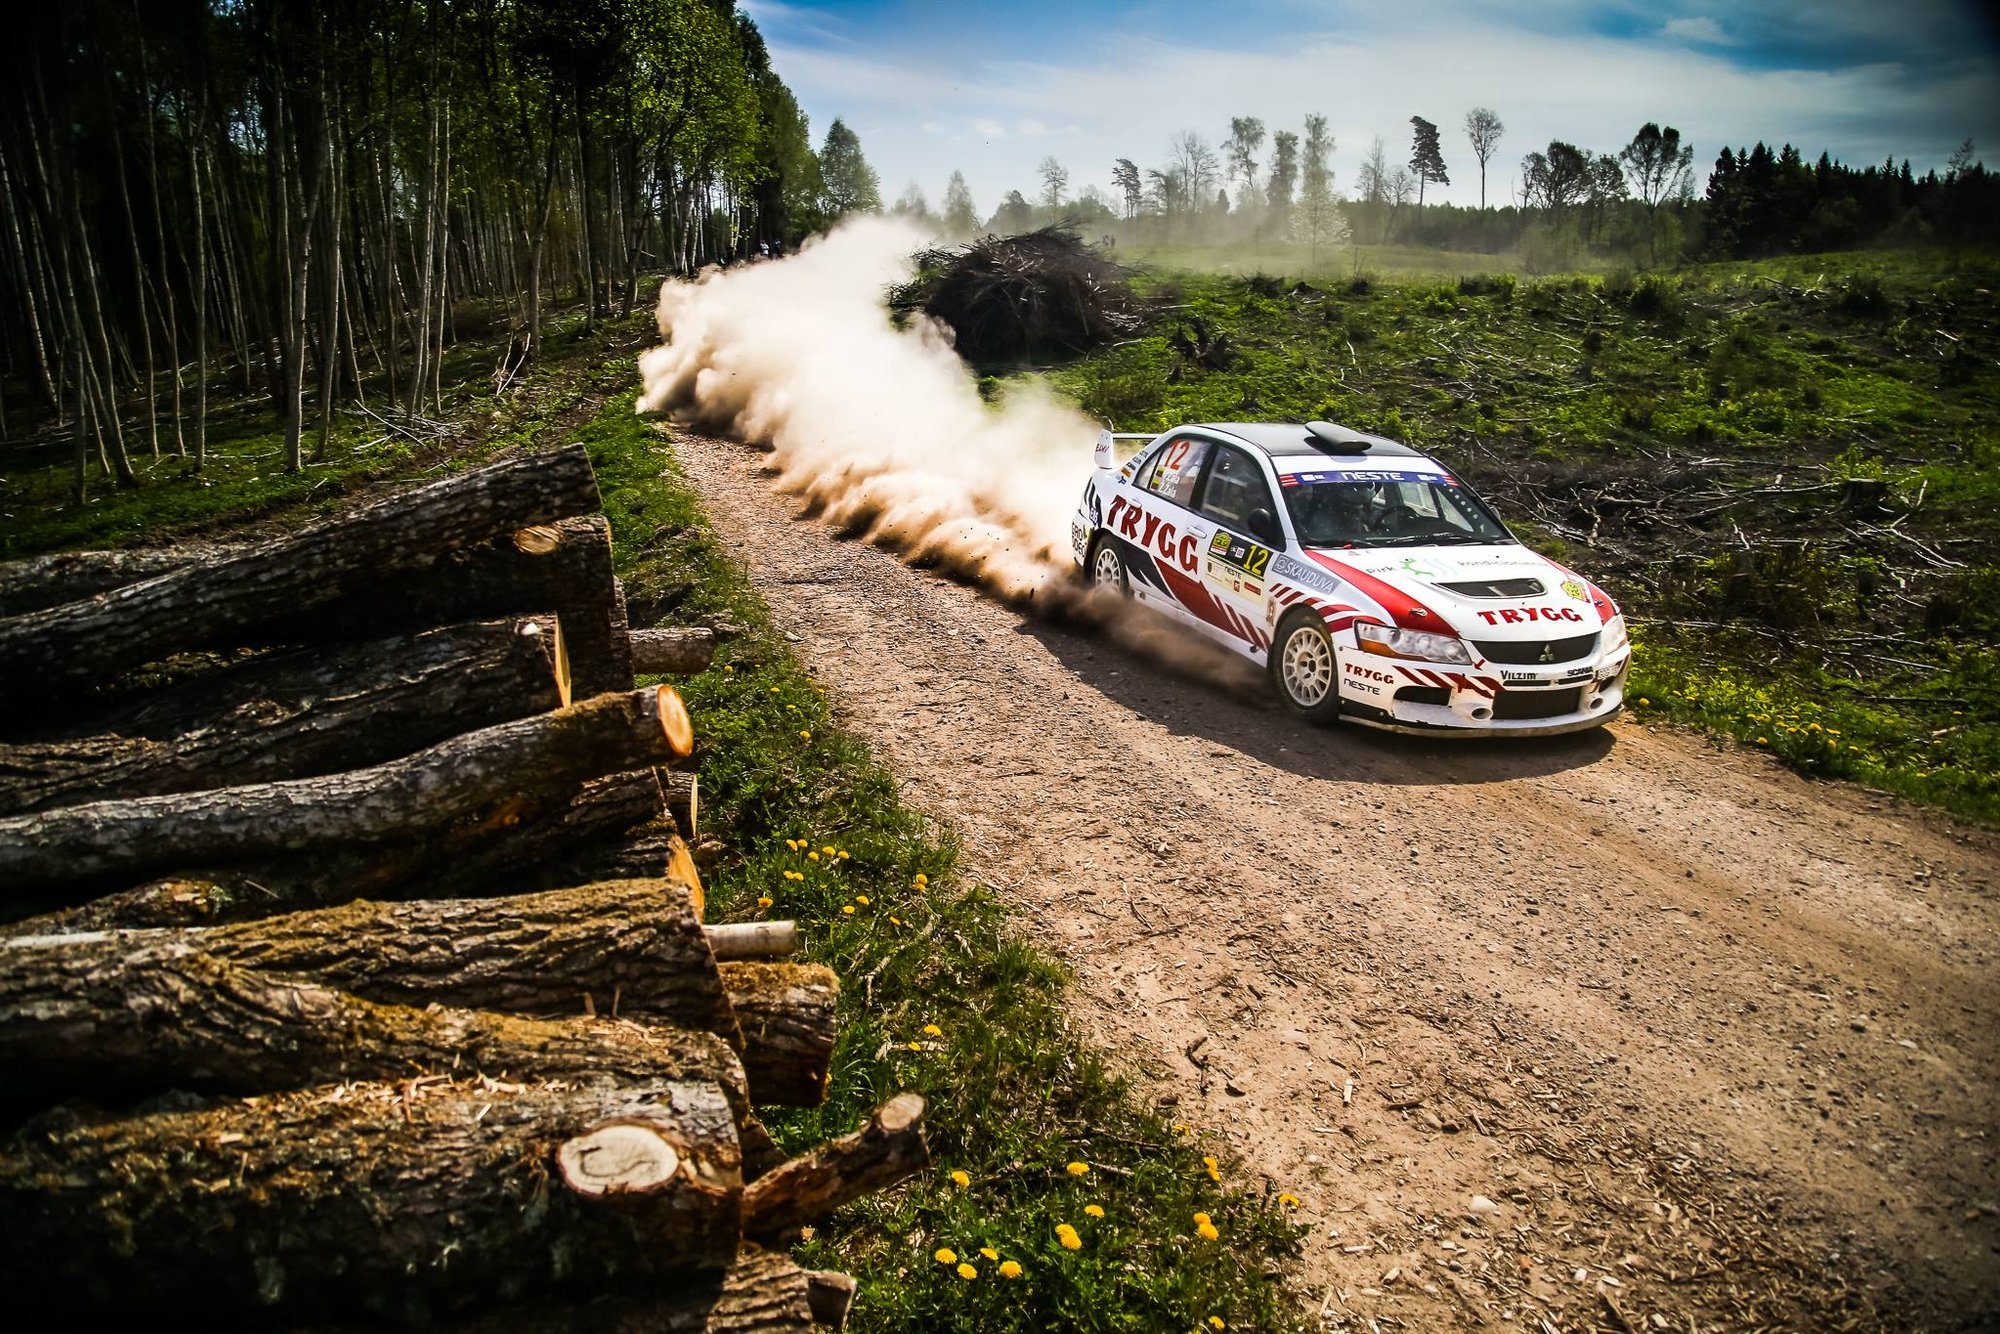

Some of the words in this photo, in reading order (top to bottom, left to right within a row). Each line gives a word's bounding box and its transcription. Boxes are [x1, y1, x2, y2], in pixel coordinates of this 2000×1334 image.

[1164, 439, 1191, 470] 12
[1341, 471, 1405, 481] NESTE
[1107, 494, 1198, 575] TRYGG
[1243, 545, 1269, 575] 12
[1224, 566, 1242, 580] NESTE
[1284, 562, 1335, 593] SKAUDUVA
[1477, 608, 1584, 625] TRYGG
[1345, 663, 1394, 685] TRYGG
[1567, 666, 1593, 677] SCANIA
[1344, 678, 1381, 696] NESTE
